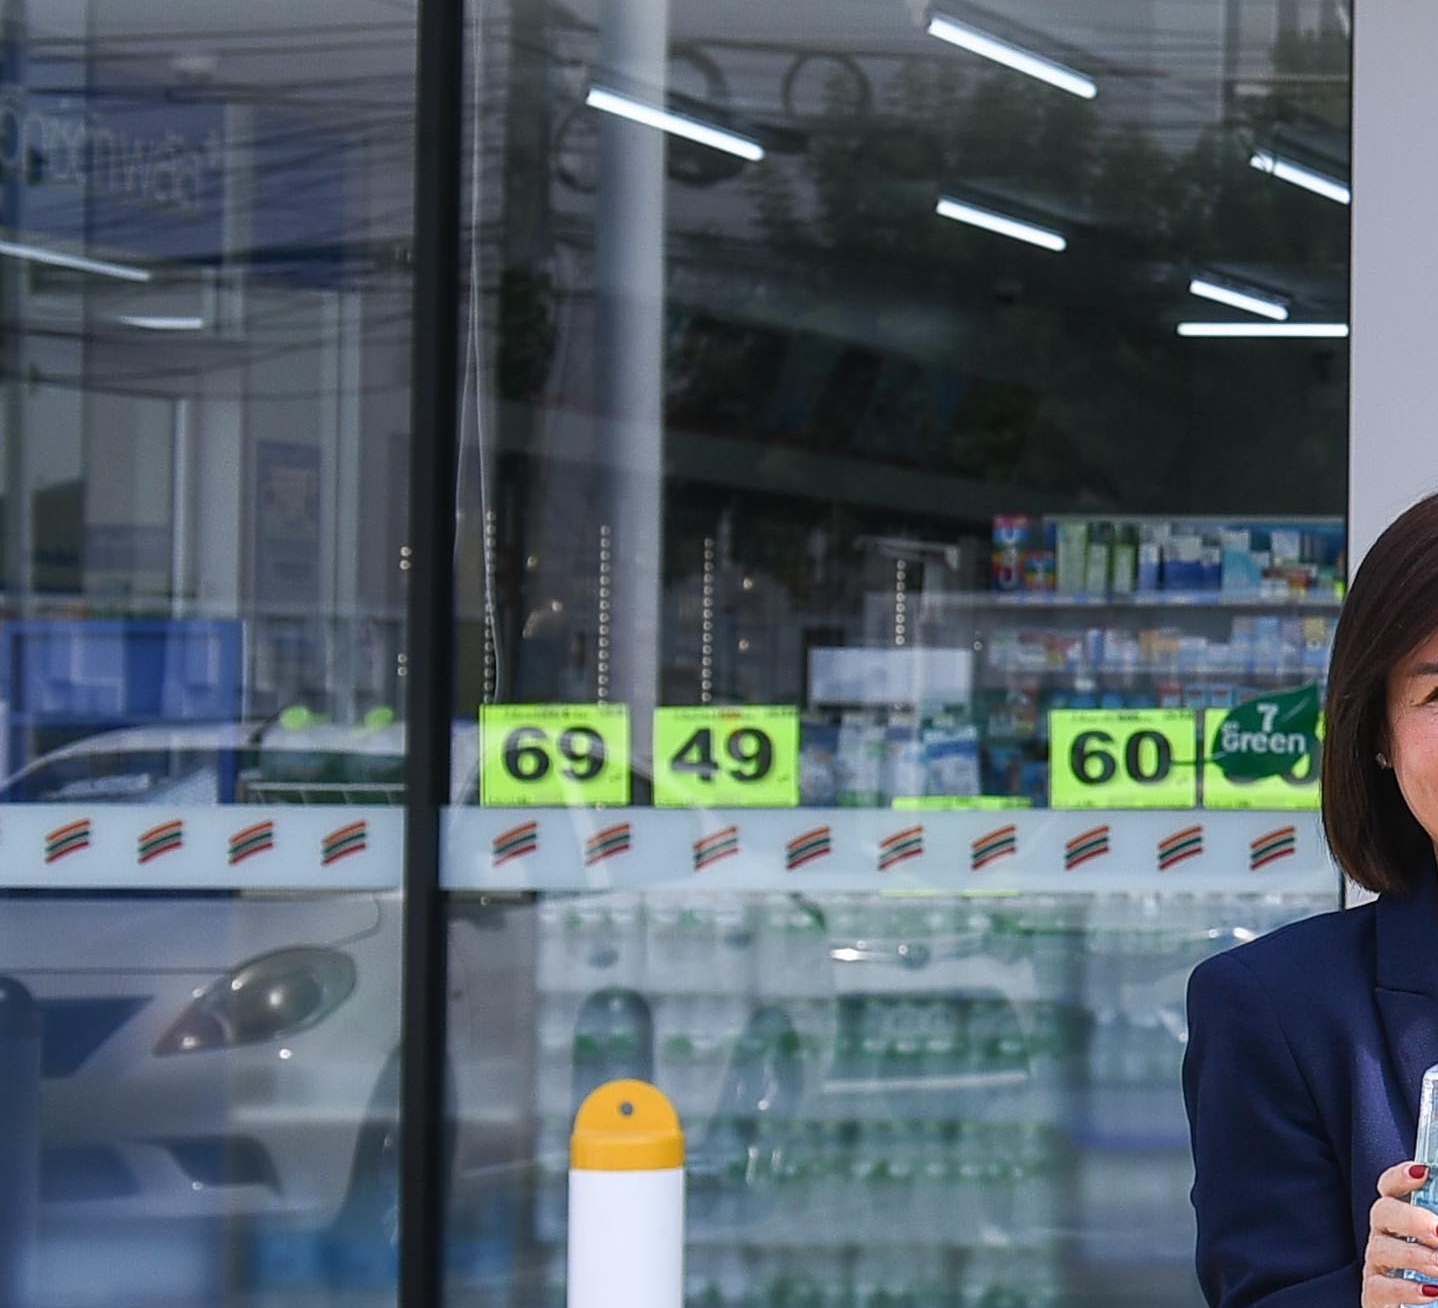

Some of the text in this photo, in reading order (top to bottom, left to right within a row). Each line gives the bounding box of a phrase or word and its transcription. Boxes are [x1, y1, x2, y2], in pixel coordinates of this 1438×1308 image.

[1221, 732, 1306, 755] Green
[1256, 703, 1279, 733] 7
[504, 726, 606, 782] 69
[670, 727, 772, 783] 49
[1070, 730, 1172, 785] 60
